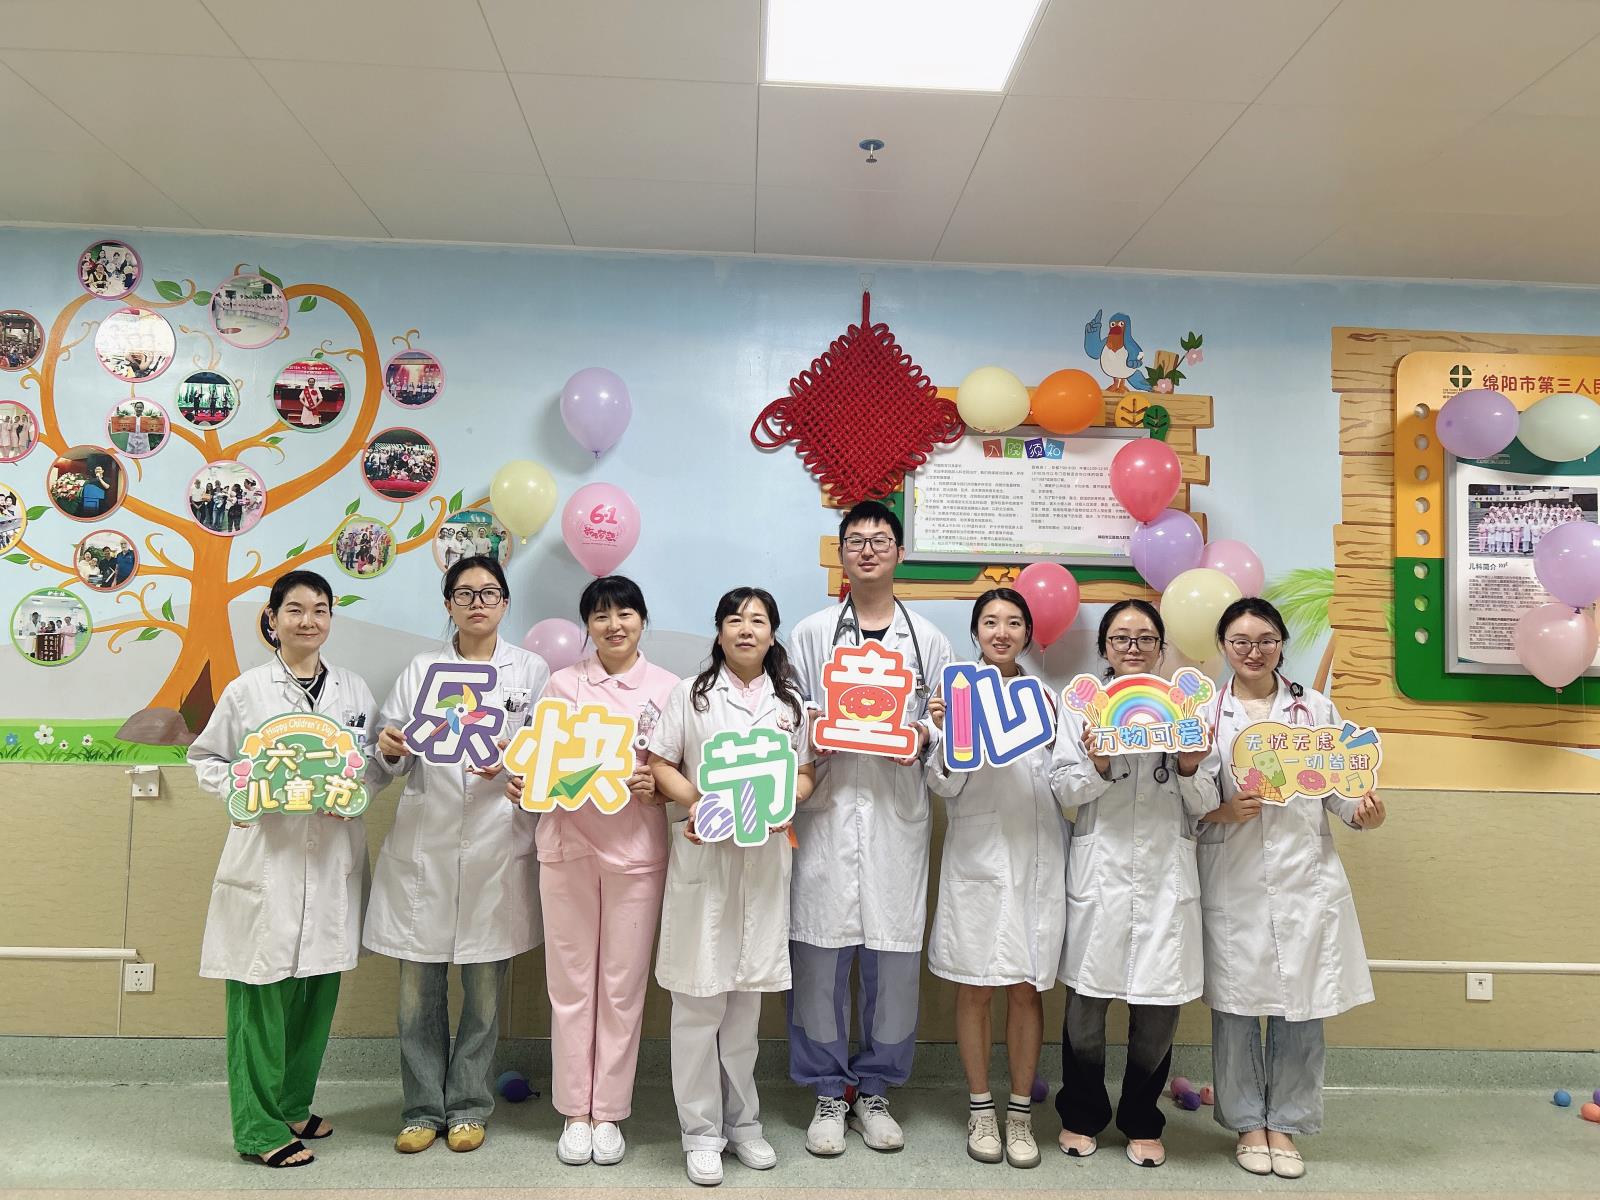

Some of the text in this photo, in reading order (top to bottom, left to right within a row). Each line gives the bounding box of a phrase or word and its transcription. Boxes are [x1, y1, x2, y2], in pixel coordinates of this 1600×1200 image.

[984, 440, 1062, 458] 入院须知
[1468, 562, 1497, 571] 儿科简介
[407, 667, 505, 764] 乐
[820, 647, 911, 751] 童
[948, 668, 1047, 764] 心
[265, 718, 336, 737] Happy Children's Day
[1091, 718, 1205, 752] 万物可爱
[1245, 732, 1336, 751] 无忧无虑
[267, 743, 335, 771] 六一
[512, 704, 627, 805] 快
[1283, 753, 1371, 771] 一切皆甜
[247, 775, 358, 812] 儿童节
[703, 733, 789, 836] 节
